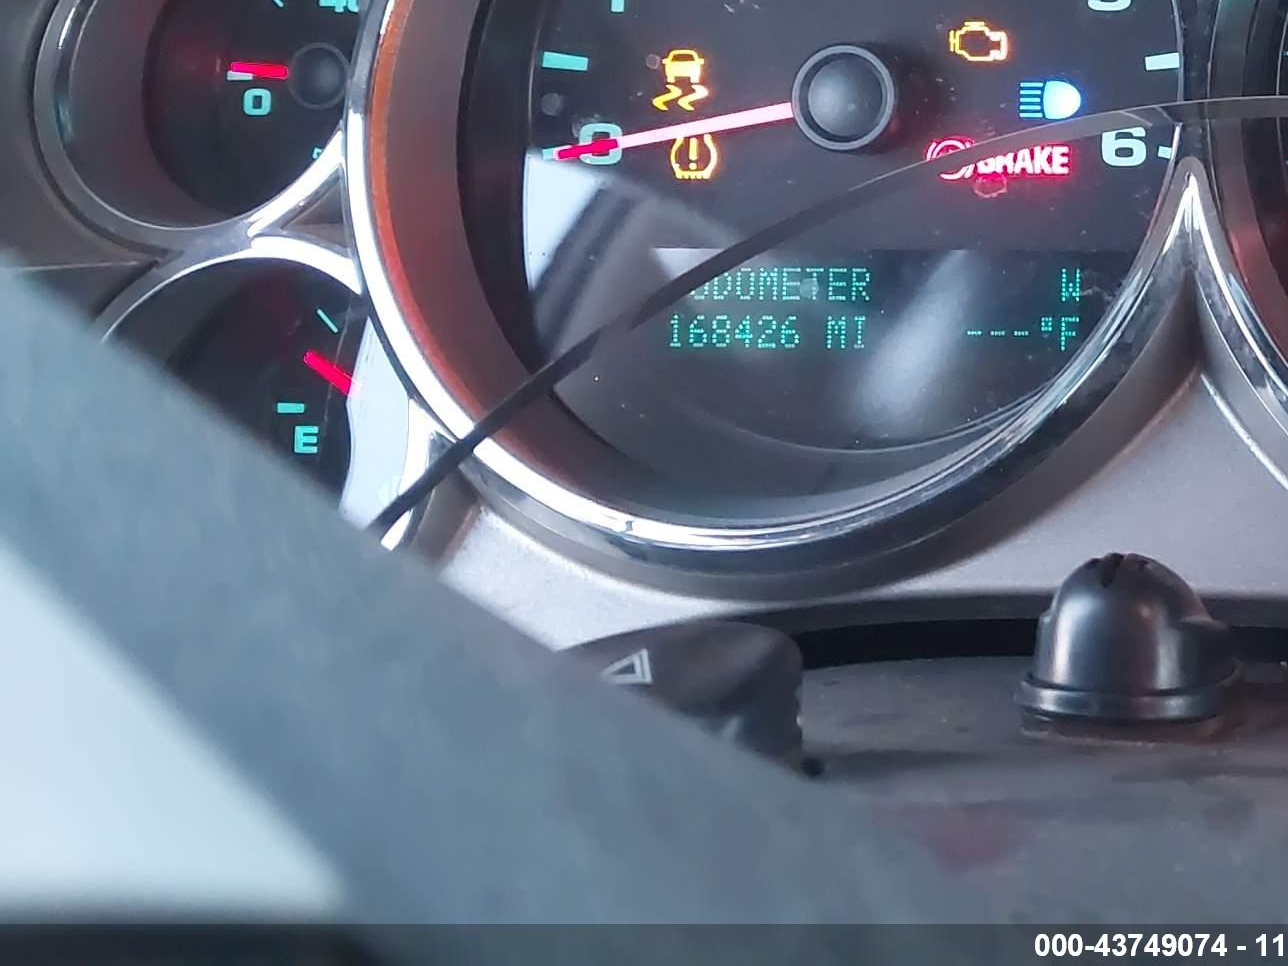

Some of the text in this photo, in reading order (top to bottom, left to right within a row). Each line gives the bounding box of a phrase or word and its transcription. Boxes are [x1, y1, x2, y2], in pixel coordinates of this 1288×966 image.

[244, 89, 271, 115] 0
[578, 122, 624, 166] 0
[977, 146, 1069, 175] BRAKE
[1102, 127, 1146, 166] 6
[1061, 268, 1080, 301] W
[669, 314, 865, 349] 168426 MI
[295, 426, 318, 453] E
